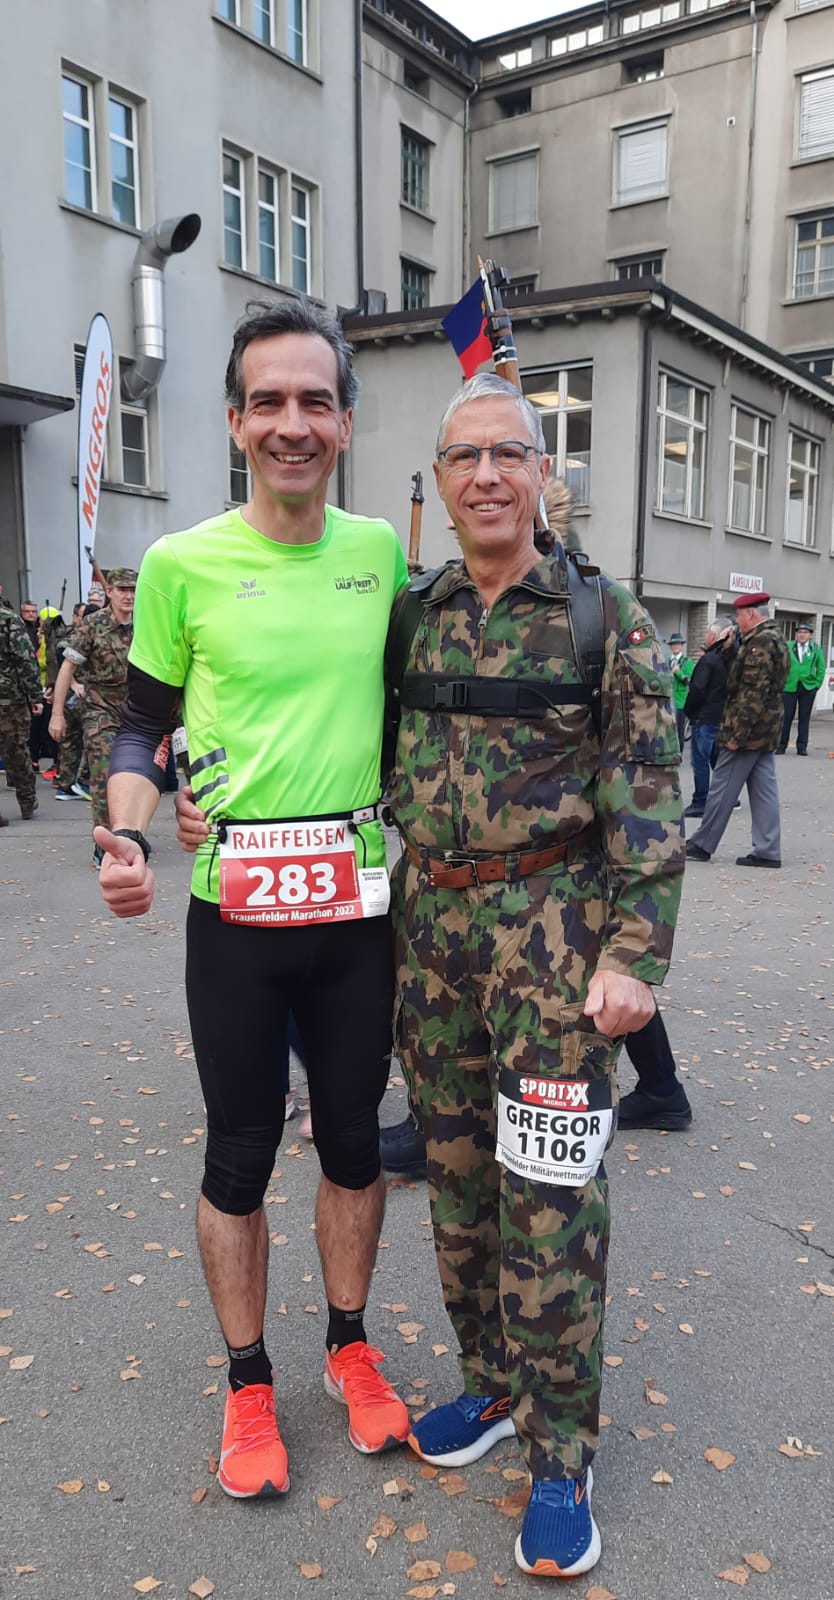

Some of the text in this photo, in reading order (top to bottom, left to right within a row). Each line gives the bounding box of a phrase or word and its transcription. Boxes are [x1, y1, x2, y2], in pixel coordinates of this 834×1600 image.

[82, 351, 111, 529] MIGROS
[236, 589, 266, 599] erima
[732, 575, 761, 591] AMBULANZ
[232, 827, 345, 850] RAIFFEISEN
[246, 862, 337, 906] 283
[230, 912, 289, 922] Frauenfelder
[291, 907, 333, 921] Marathon
[334, 905, 355, 916] 2022
[519, 1078, 589, 1107] SPORTXX
[543, 1099, 567, 1107] MIGROS
[506, 1104, 600, 1137] GREGOR
[517, 1132, 586, 1164] 1106
